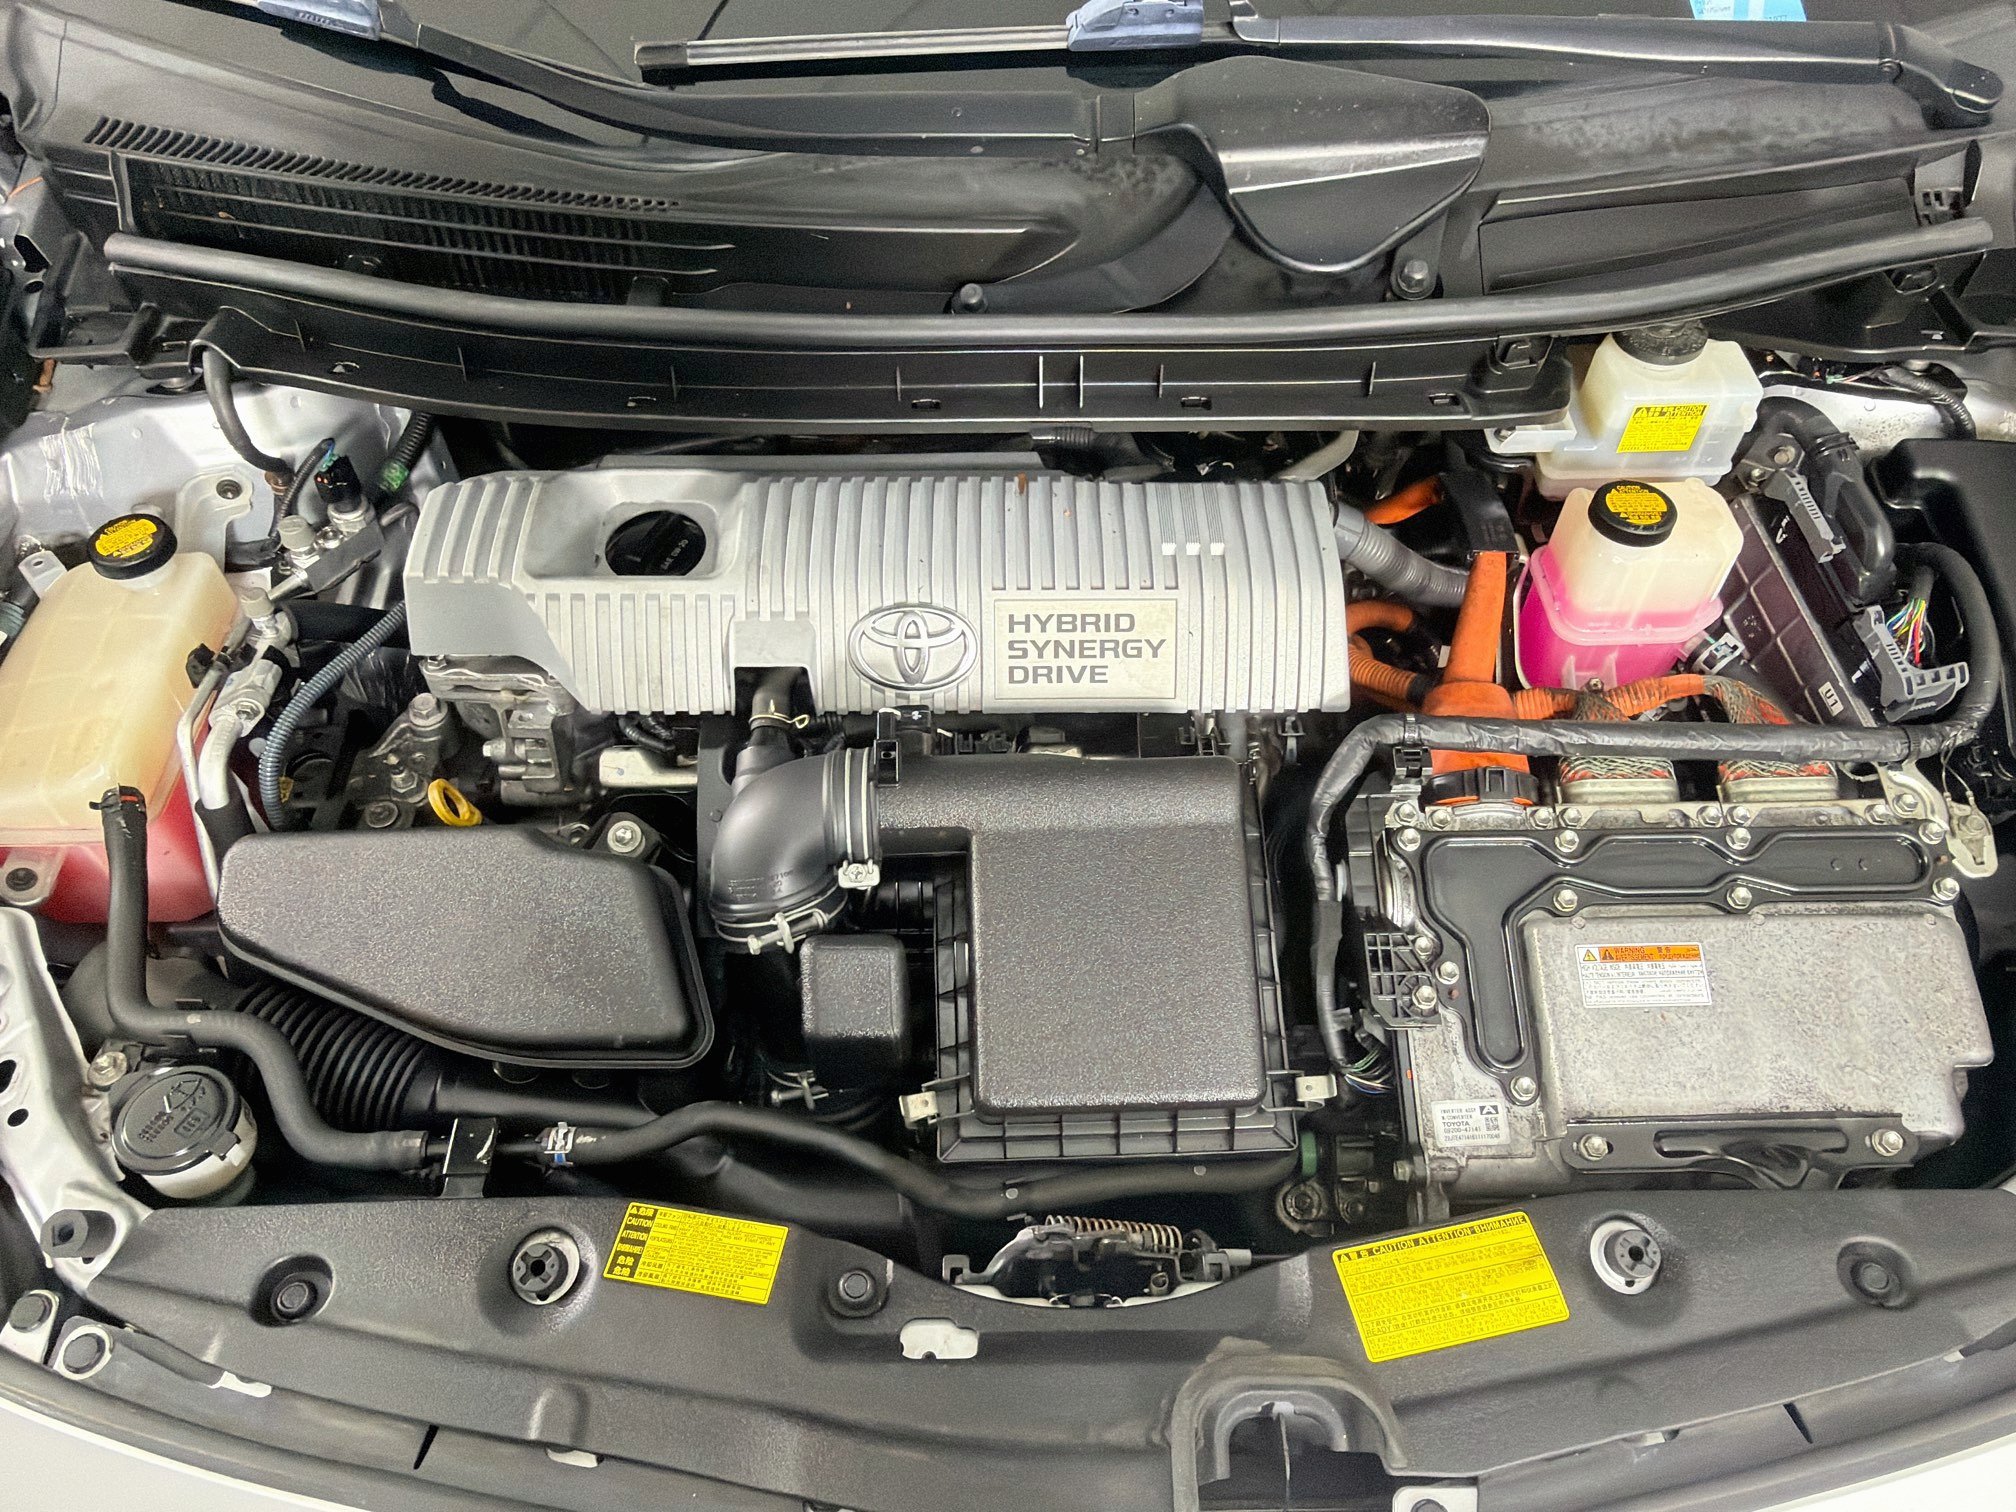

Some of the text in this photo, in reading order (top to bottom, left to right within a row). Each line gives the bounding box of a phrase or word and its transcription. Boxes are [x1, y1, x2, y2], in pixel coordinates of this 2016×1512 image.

[1008, 613, 1136, 633] HYBRID
[1008, 639, 1167, 659] SYNERGY
[1008, 665, 1109, 684] DRIVE
[1825, 689, 1838, 707] U1
[1613, 946, 1646, 954] WARNING
[626, 1216, 653, 1228] CAUTION
[621, 1229, 649, 1241] ATTENTION
[1372, 1216, 1526, 1255] CAUTION ATTENTION ВНИМАНИЕ
